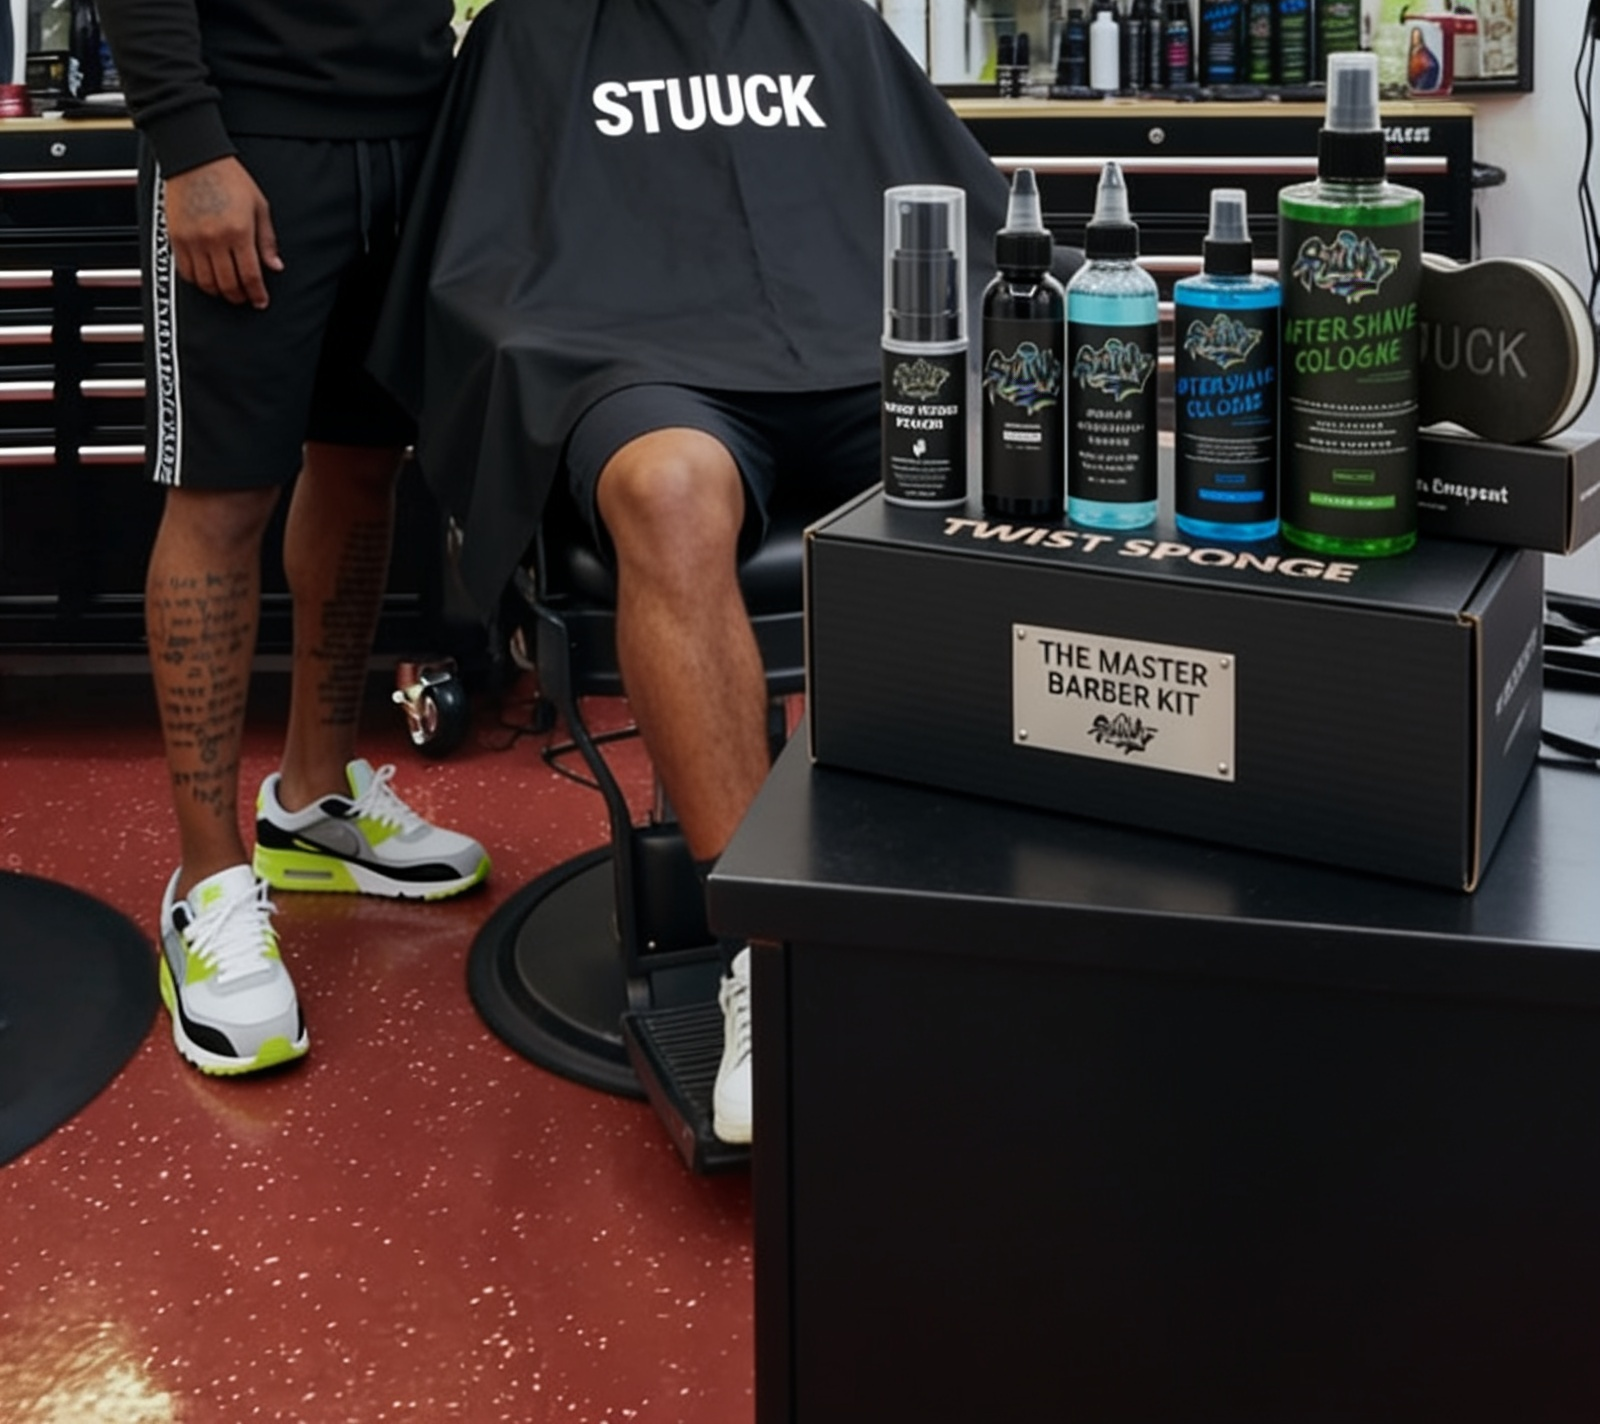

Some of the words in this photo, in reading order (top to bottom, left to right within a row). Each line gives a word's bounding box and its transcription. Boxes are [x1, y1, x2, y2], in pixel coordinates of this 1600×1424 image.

[592, 73, 827, 136] STUUCK
[943, 516, 1113, 553] TWIST
[1118, 539, 1359, 584] SPONGE
[1038, 639, 1092, 670] THE
[1099, 648, 1208, 688] MASTER
[1048, 671, 1150, 709] BARBER
[1157, 687, 1200, 717] KIT
